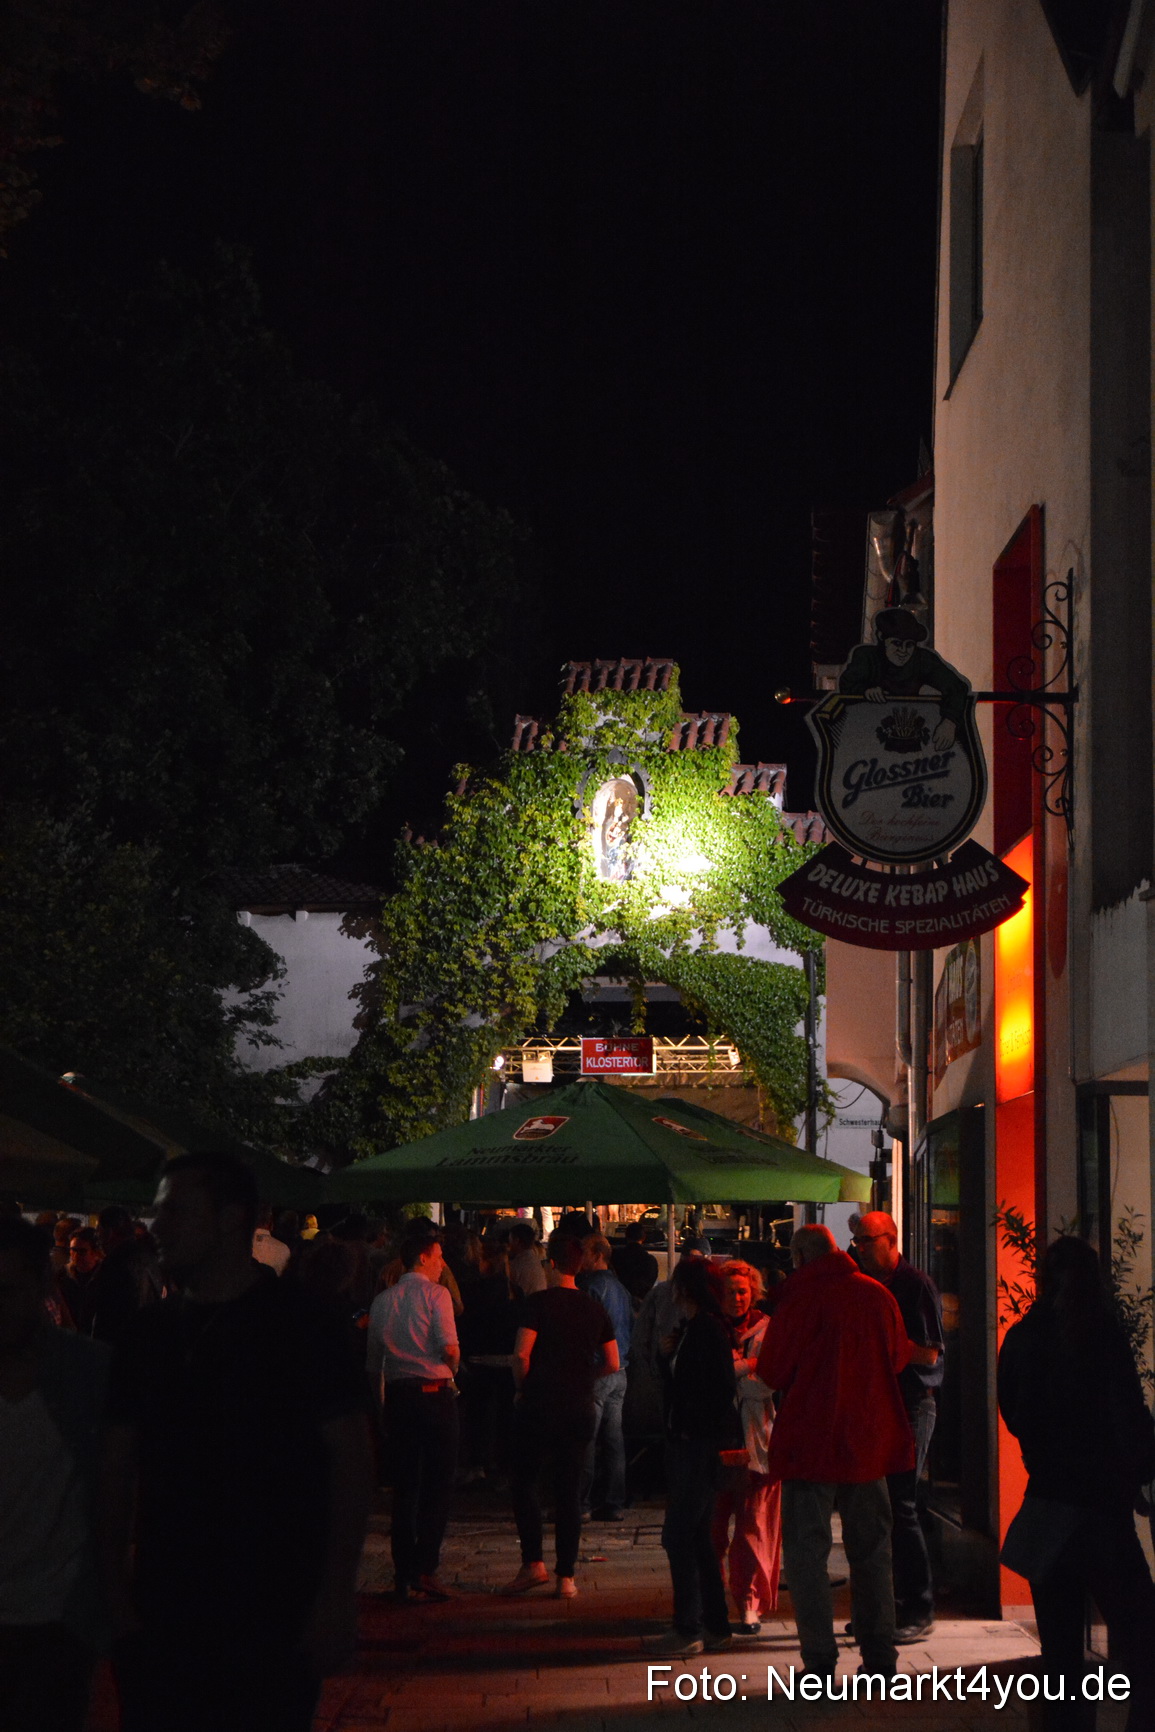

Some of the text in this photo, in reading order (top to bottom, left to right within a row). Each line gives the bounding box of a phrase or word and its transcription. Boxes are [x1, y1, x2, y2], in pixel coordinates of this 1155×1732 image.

[842, 752, 955, 808] Glossner
[901, 784, 954, 808] Bier
[807, 860, 999, 907] DELUXE KEBAP HAUS
[801, 894, 1010, 934] TÜRKISCHE SPEZIALITÄTEN
[586, 1056, 649, 1068] KLOSTERTOR
[839, 1118, 882, 1126] Schwesterhau
